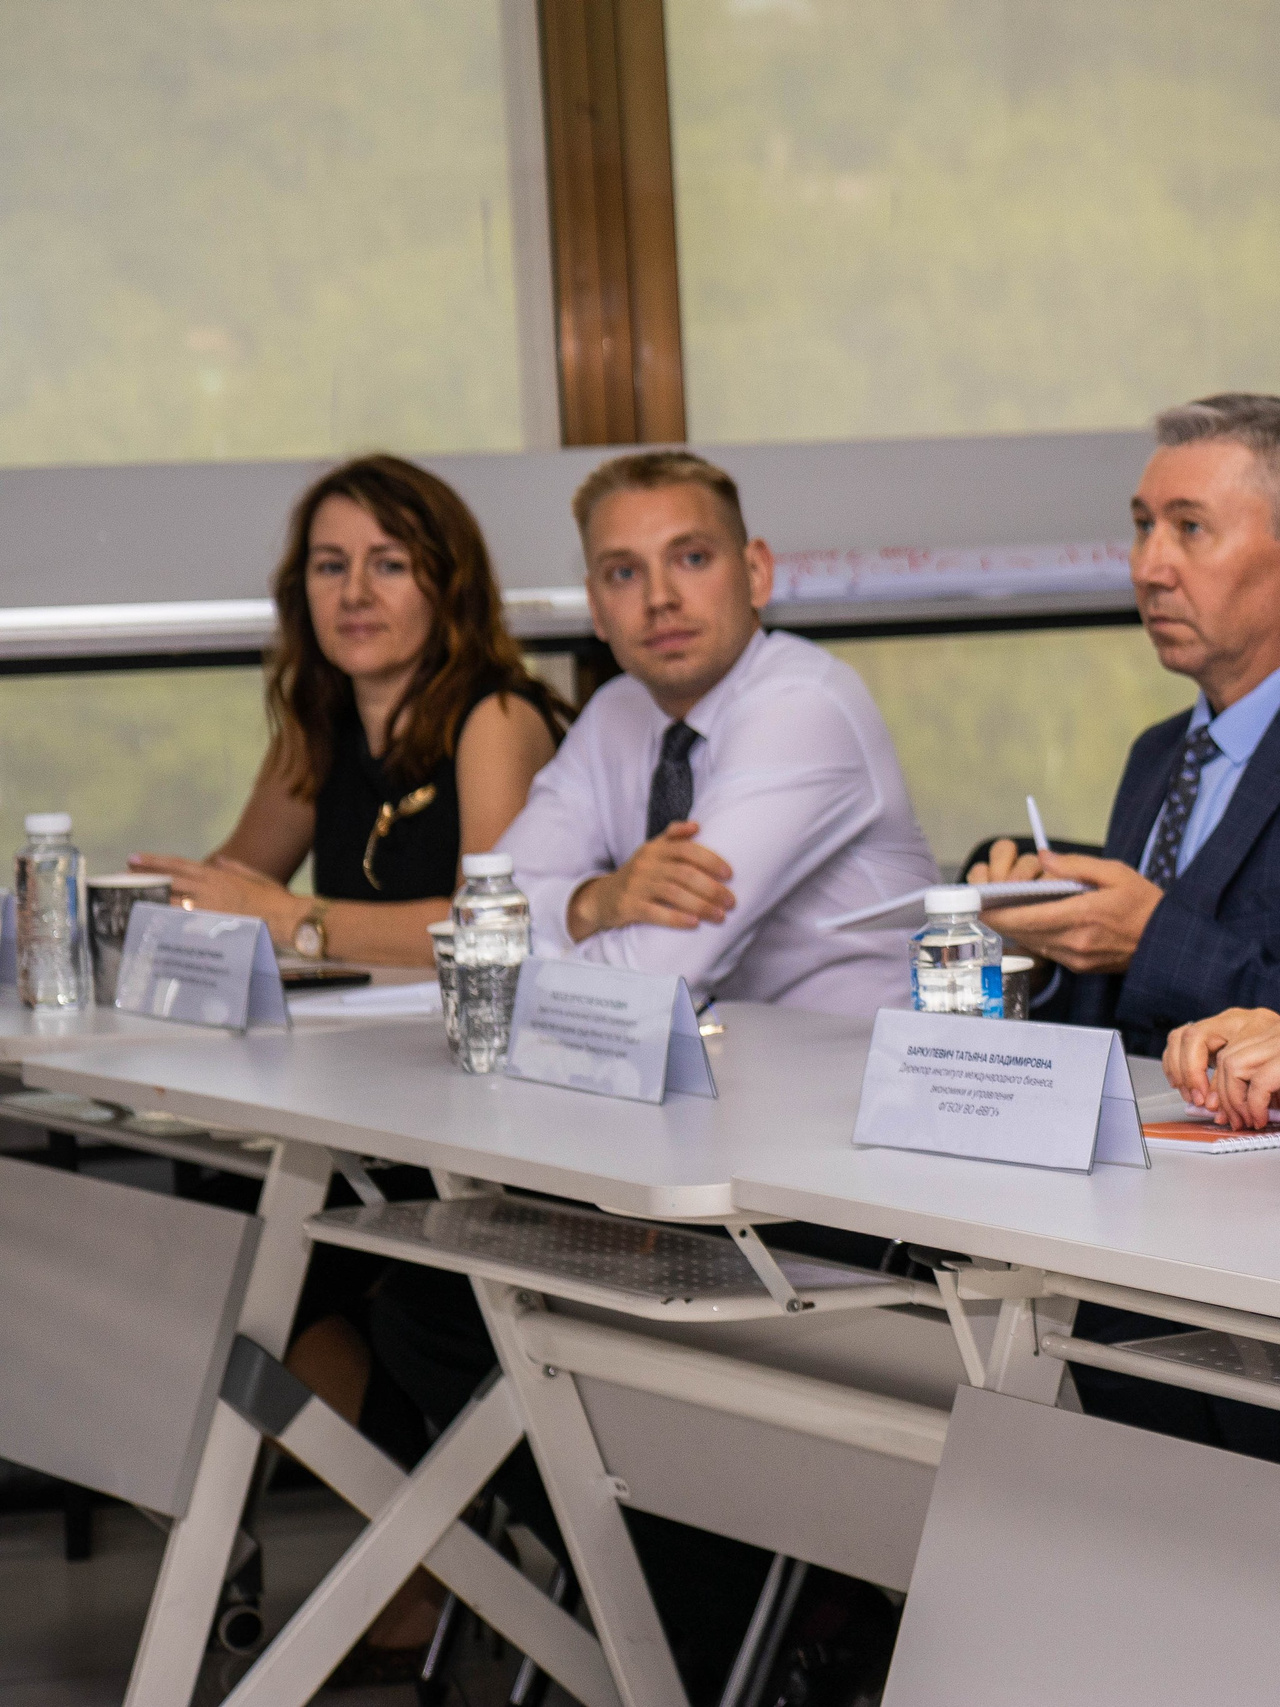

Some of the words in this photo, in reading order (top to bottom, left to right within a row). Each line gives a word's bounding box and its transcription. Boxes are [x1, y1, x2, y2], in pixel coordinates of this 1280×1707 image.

[955, 1050, 987, 1062] ТАТЬЯНА
[989, 1054, 1052, 1069] ВЛАДИМИРОВНА
[899, 1061, 931, 1075] Директор
[932, 1067, 963, 1079] института
[964, 1071, 1022, 1085] международного
[971, 1090, 1014, 1101] управления
[938, 1101, 963, 1113] ФГБОУ
[963, 1104, 975, 1115] ВО
